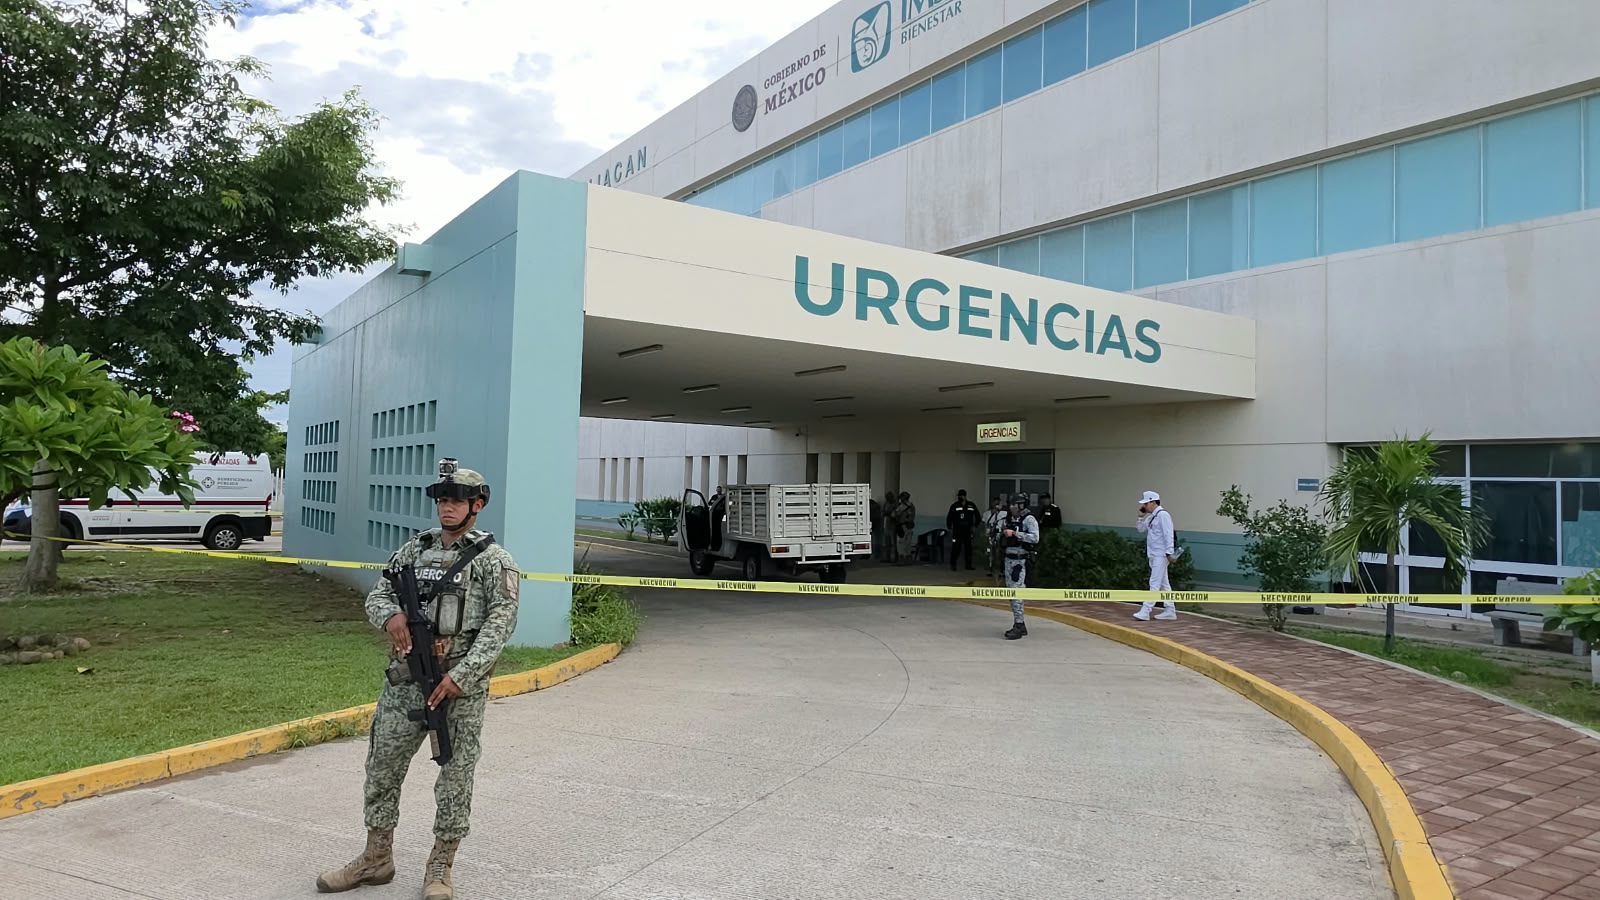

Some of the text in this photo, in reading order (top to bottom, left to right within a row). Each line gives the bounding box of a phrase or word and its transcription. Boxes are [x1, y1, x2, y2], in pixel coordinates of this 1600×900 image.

[901, 1, 962, 45] BIENESTAR
[764, 44, 826, 89] GOBIERNO DE
[764, 66, 826, 115] MÉXICO
[794, 254, 1162, 364] URGENCIAS
[979, 427, 1018, 439] URGENCIAS
[414, 568, 462, 583] EJERCO
